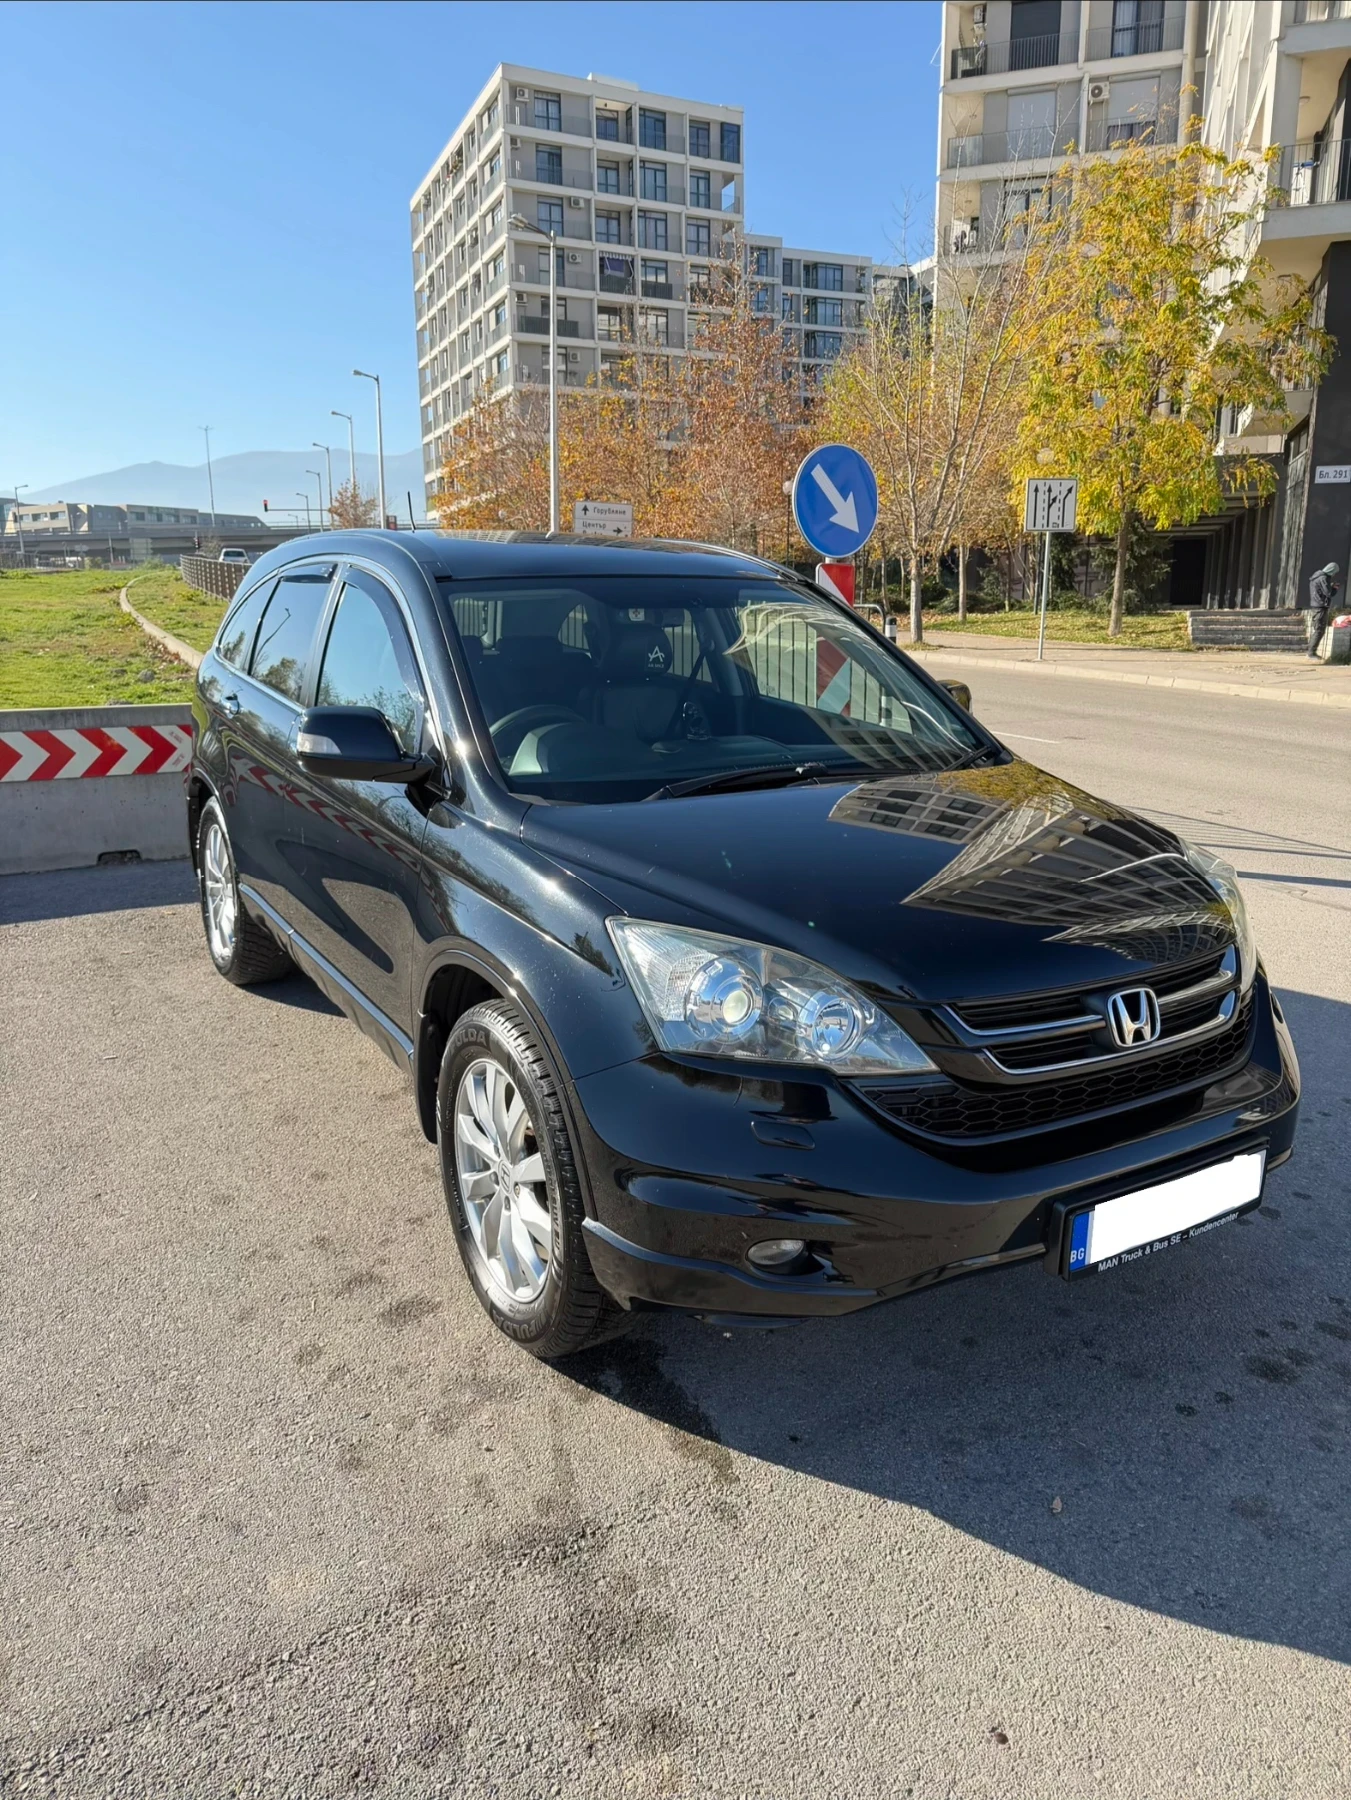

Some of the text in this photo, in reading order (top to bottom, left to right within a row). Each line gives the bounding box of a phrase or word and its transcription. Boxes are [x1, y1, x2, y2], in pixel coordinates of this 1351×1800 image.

[1319, 470, 1347, 479] Бл. 291
[583, 521, 606, 530] Център
[1098, 1257, 1119, 1272] MAN
[1121, 1248, 1143, 1264] Truck
[1144, 1245, 1151, 1255] &
[1152, 1240, 1169, 1251] Bus
[1170, 1234, 1181, 1245] SE
[1189, 1212, 1239, 1238] Kundencenter
[1070, 1247, 1085, 1263] BG
